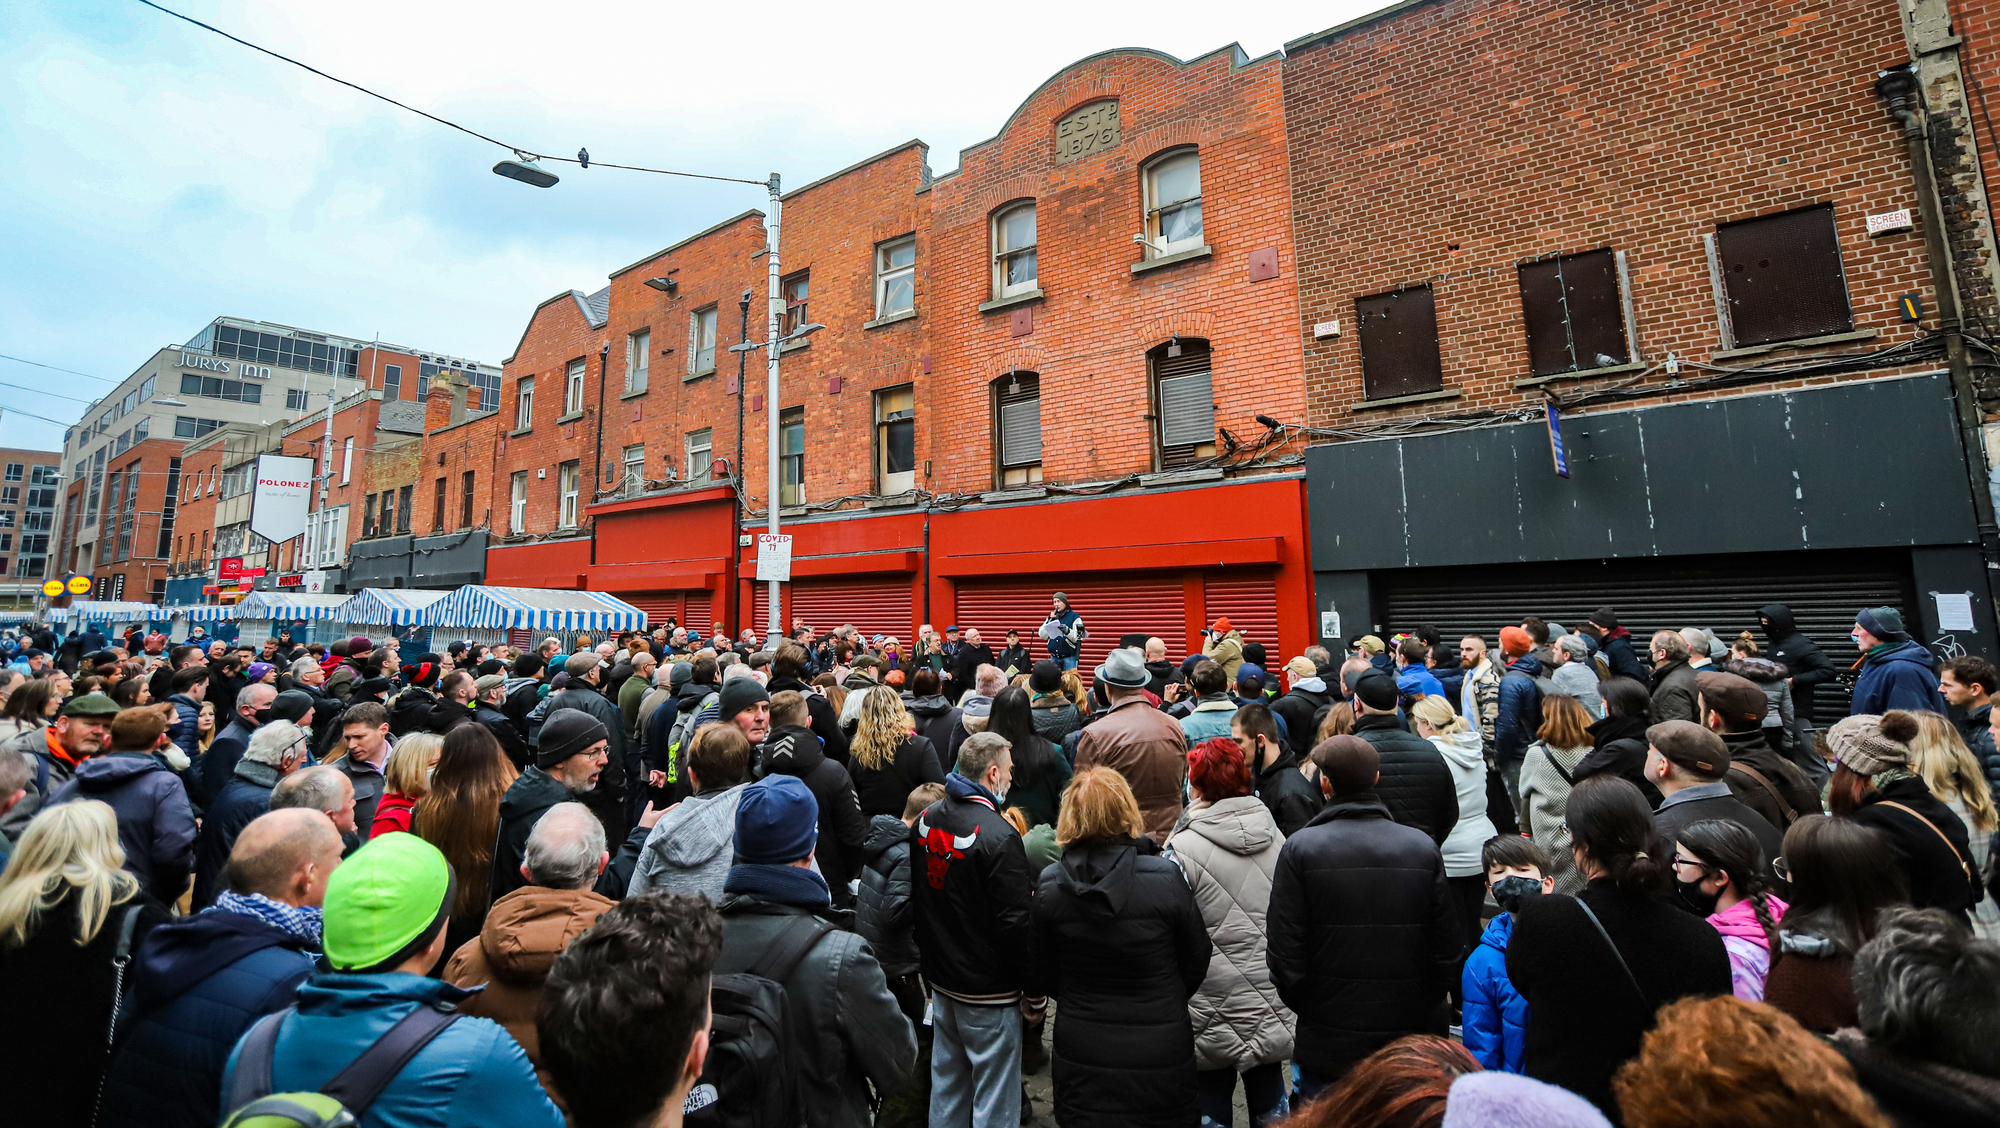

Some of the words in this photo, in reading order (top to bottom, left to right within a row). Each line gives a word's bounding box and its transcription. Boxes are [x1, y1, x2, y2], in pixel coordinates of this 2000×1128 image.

[1870, 212, 1907, 226] SCREEN
[1871, 221, 1908, 231] SECURITY
[1315, 322, 1336, 331] SCREEN
[173, 351, 231, 373] JURYS
[259, 479, 310, 489] POLONEZ
[688, 1085, 702, 1098] HE
[683, 1100, 704, 1116] FACE
